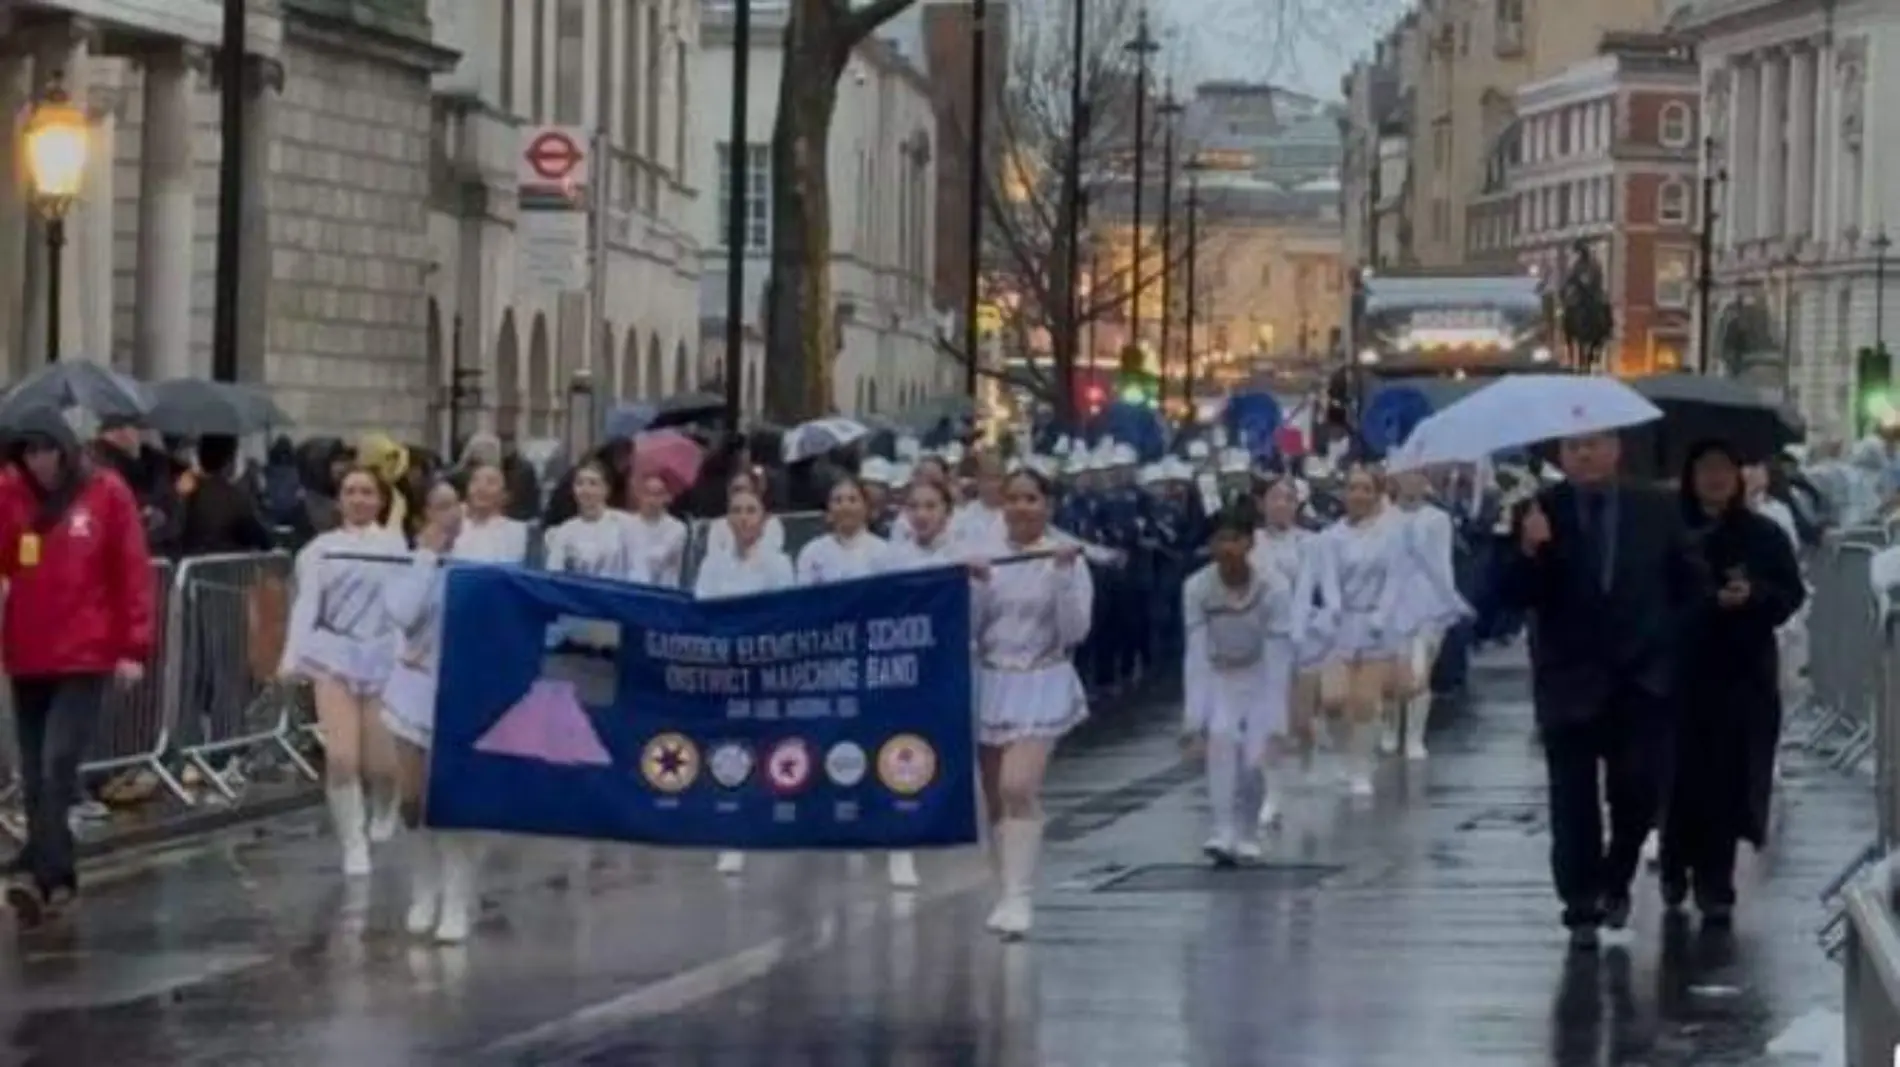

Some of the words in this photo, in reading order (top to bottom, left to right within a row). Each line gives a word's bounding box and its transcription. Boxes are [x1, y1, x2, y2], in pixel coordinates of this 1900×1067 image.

[736, 622, 857, 664] ELEMENTARY
[867, 614, 936, 651] SCHOOL
[665, 665, 750, 693] DISTRICT
[761, 658, 858, 691] MARCHING
[866, 654, 918, 688] BAND
